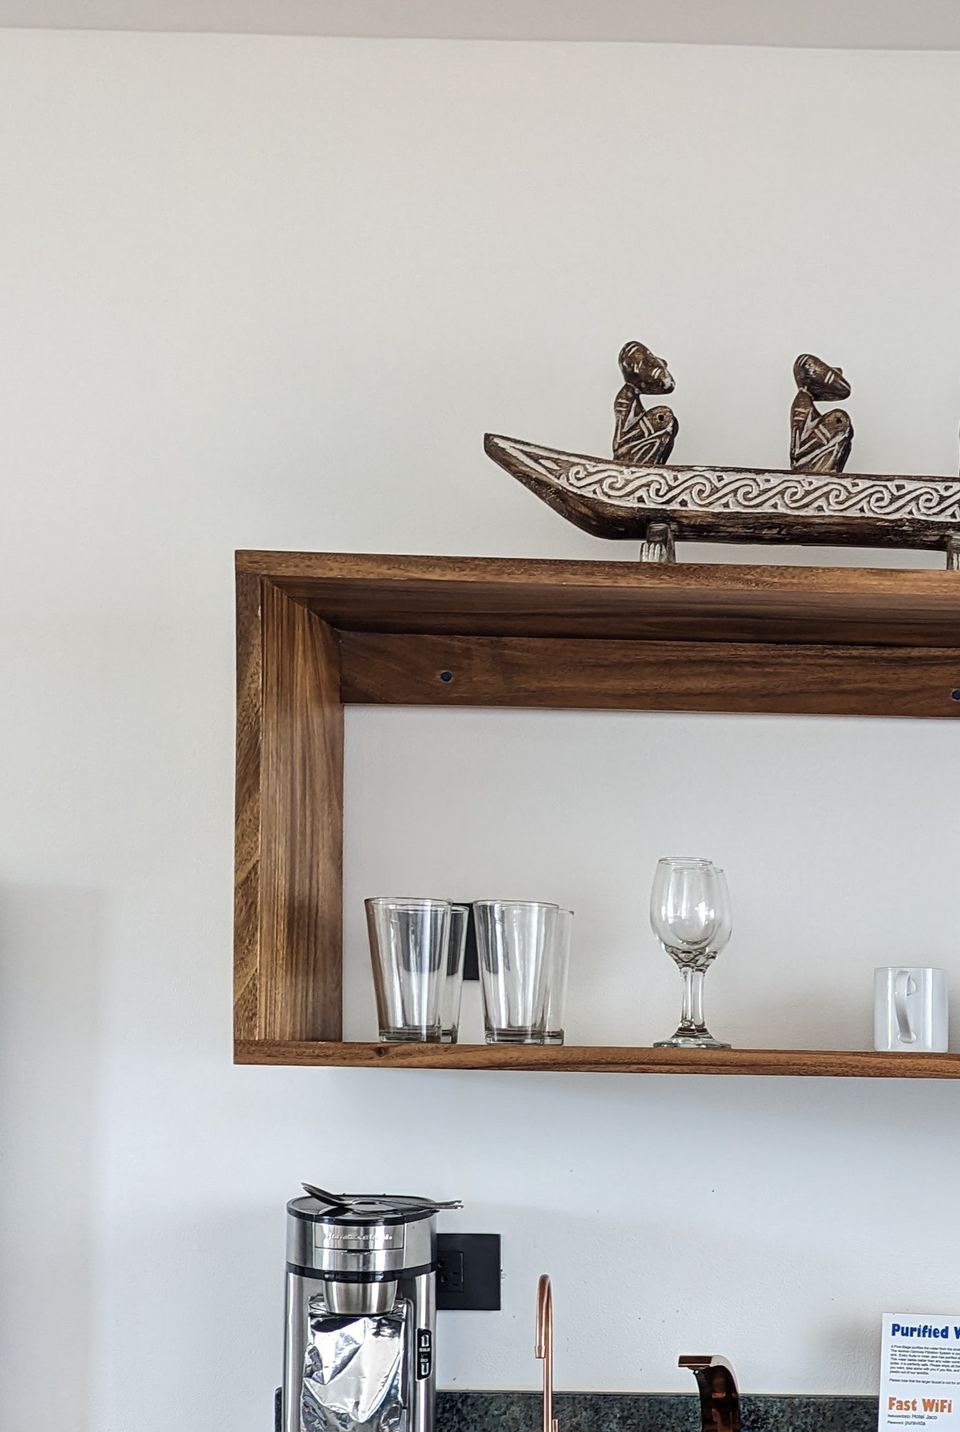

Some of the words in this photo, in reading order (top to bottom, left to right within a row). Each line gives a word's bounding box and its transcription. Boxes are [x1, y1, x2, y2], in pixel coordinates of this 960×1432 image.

[891, 1323, 949, 1339] Purified
[888, 1397, 917, 1411] Fast
[922, 1398, 952, 1413] WiFi
